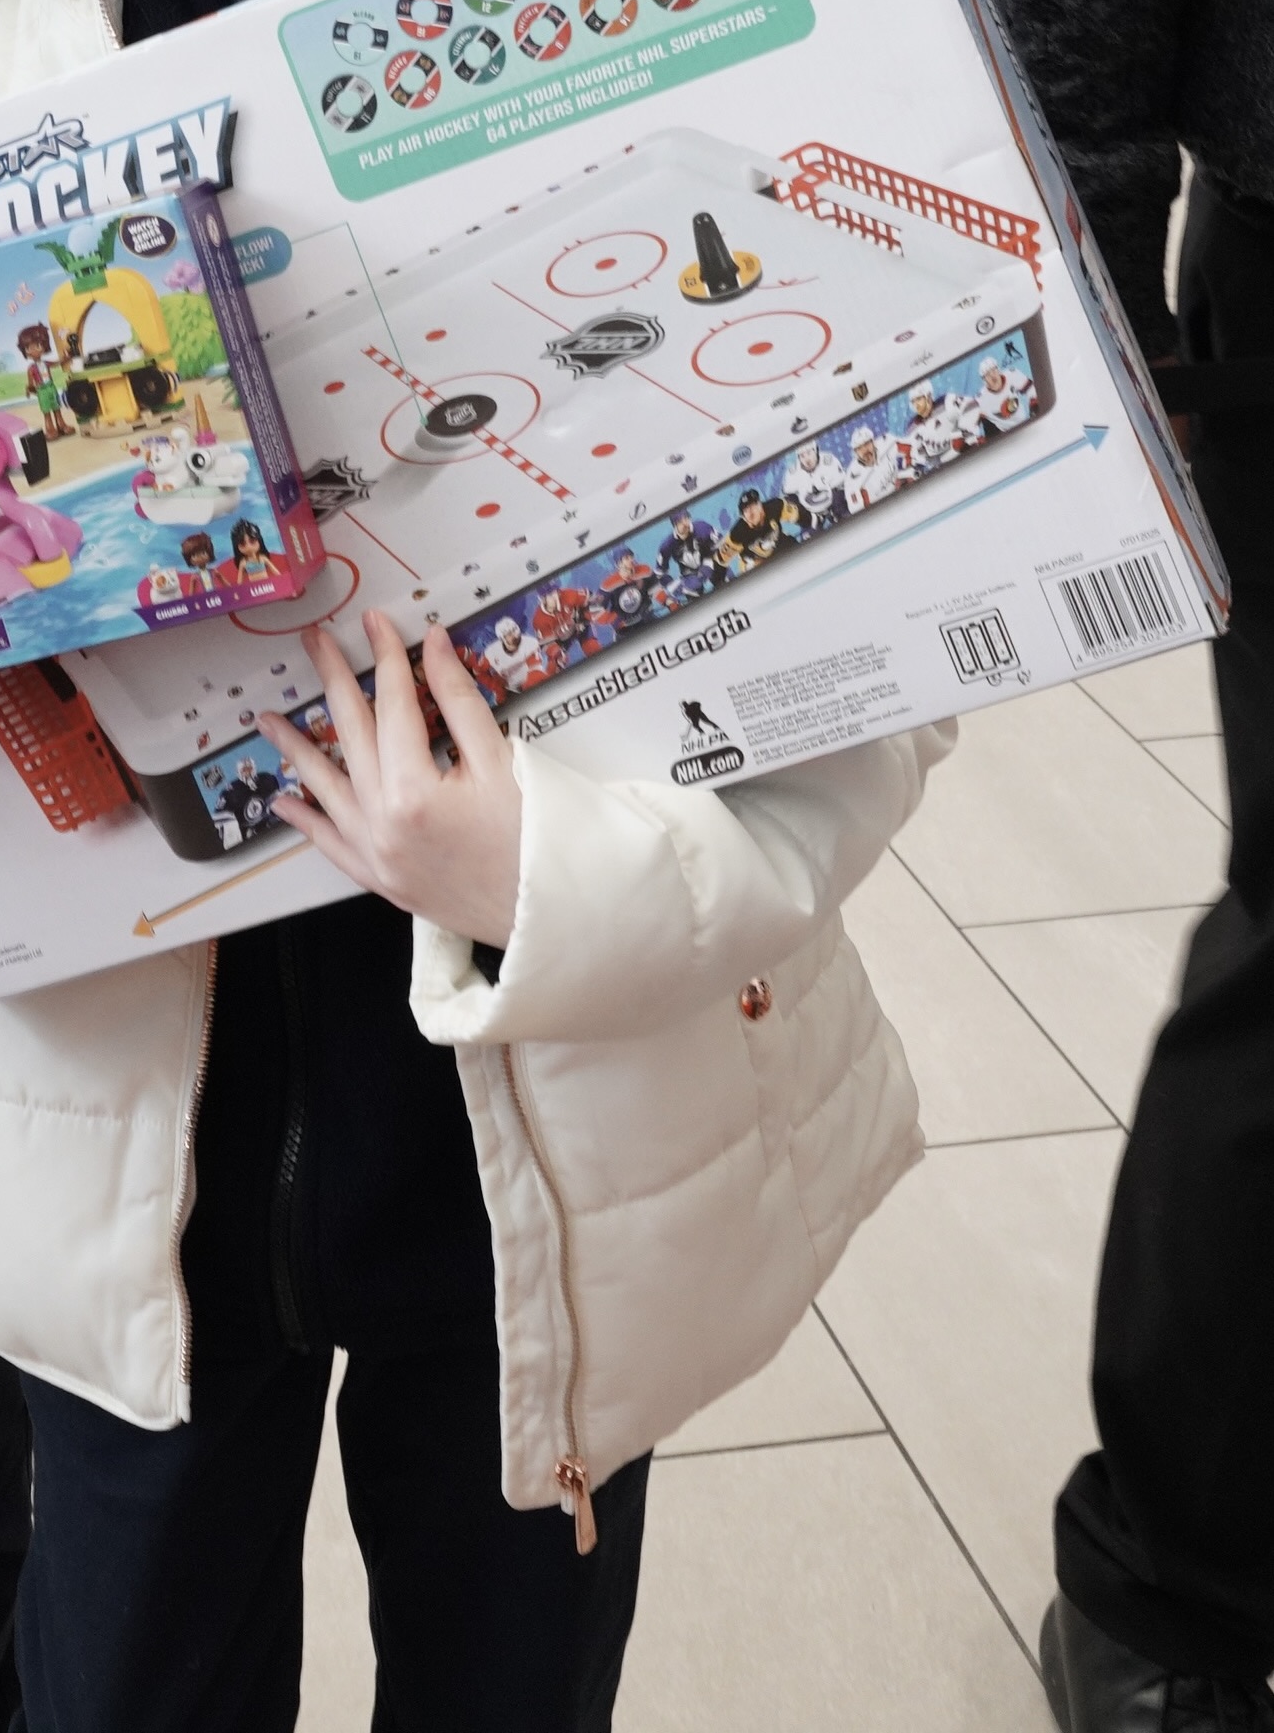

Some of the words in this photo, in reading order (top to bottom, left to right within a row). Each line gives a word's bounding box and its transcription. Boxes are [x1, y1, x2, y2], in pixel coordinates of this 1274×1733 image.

[357, 142, 396, 169] PLAY
[395, 133, 423, 156] AIR
[422, 111, 483, 145] HOCKEY
[482, 96, 523, 123] WITH
[522, 81, 565, 109] YOUR
[563, 54, 637, 93] FAVORITE
[636, 42, 669, 67] NHL
[667, 6, 768, 55] SUPERSTARS
[484, 122, 508, 143] 64
[508, 99, 575, 135] PLAYERS
[573, 69, 655, 111] INCLUDED!
[128, 217, 160, 236] WATCH
[134, 235, 167, 253] ONLINE
[155, 604, 189, 621] CHURRO
[205, 595, 223, 609] LEO
[249, 582, 276, 597] LIANN
[518, 652, 658, 741] Assembled
[656, 609, 752, 668] Length
[681, 731, 730, 755] NHLPA
[676, 752, 741, 784] NHL.com
